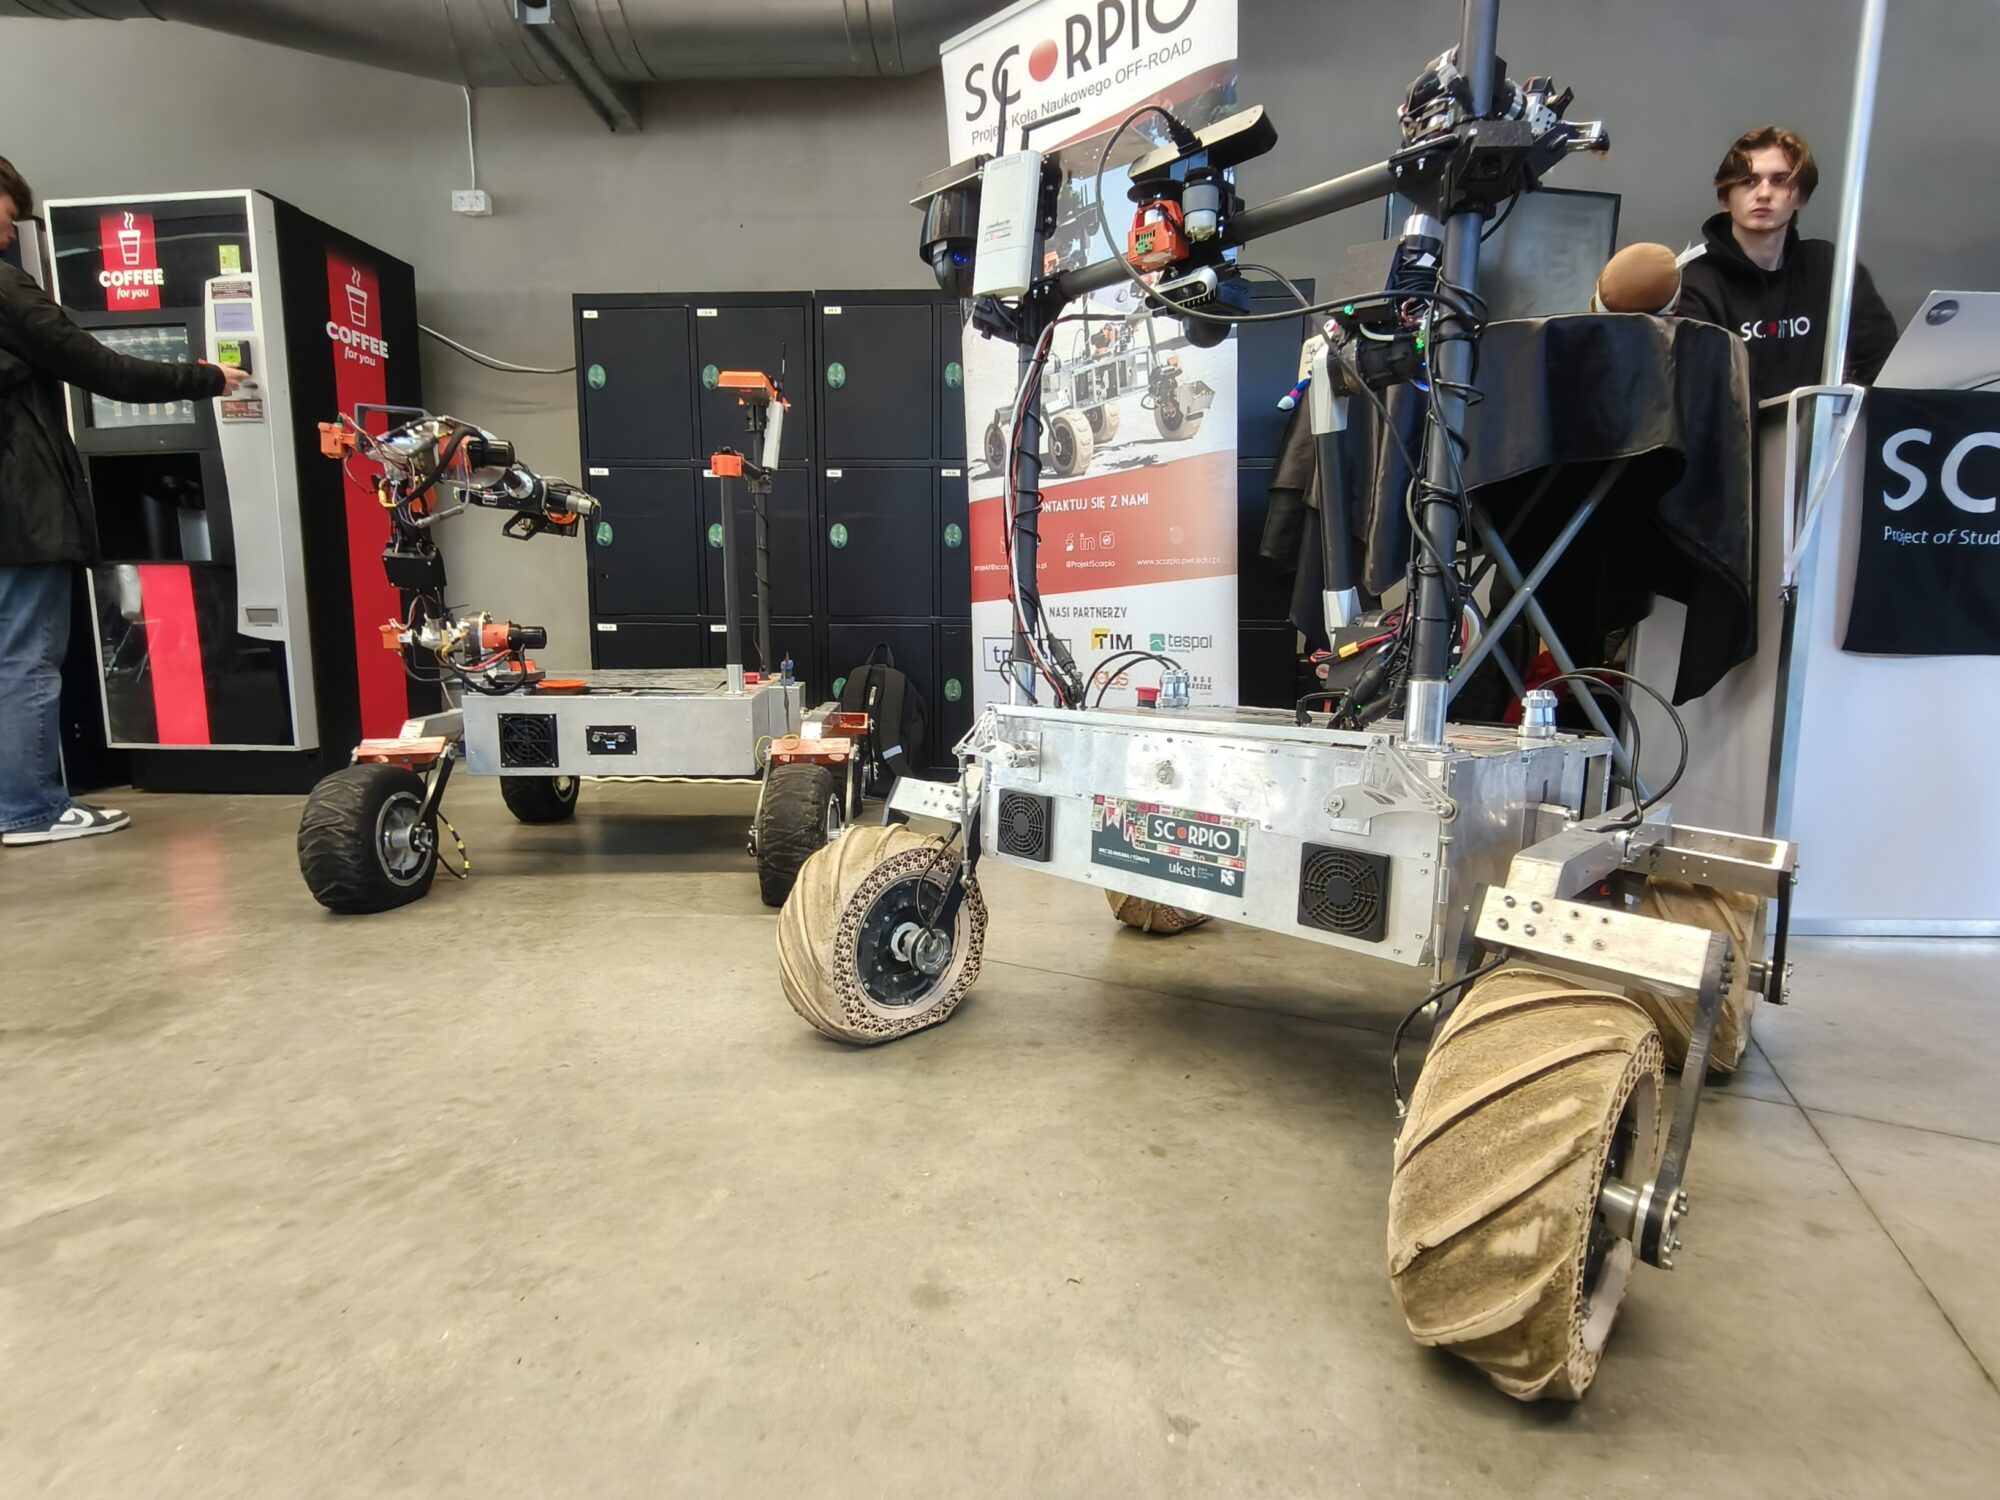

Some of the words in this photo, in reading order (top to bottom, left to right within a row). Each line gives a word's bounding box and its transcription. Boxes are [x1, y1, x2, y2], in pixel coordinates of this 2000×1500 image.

[972, 123, 1009, 146] Proje
[1041, 78, 1112, 116] Naukowego
[1115, 38, 1193, 84] OFF-ROAD
[99, 268, 164, 287] COFFEE
[116, 288, 130, 300] for
[131, 288, 149, 299] you
[326, 321, 389, 359] COFFEE
[344, 346, 358, 360] for
[359, 353, 376, 366] you
[1040, 497, 1088, 513] ONTAKTUJ
[1091, 495, 1106, 510] SIĘ
[1110, 495, 1118, 508] Z
[1121, 492, 1149, 507] NAMI
[1884, 526, 1929, 546] Project
[1933, 528, 1957, 545] of
[1049, 607, 1070, 618] NASI
[1072, 607, 1128, 619] PARTNERZY
[1094, 633, 1133, 650] TIM
[1168, 634, 1213, 651] tespol
[1153, 819, 1232, 850] SCORPIO
